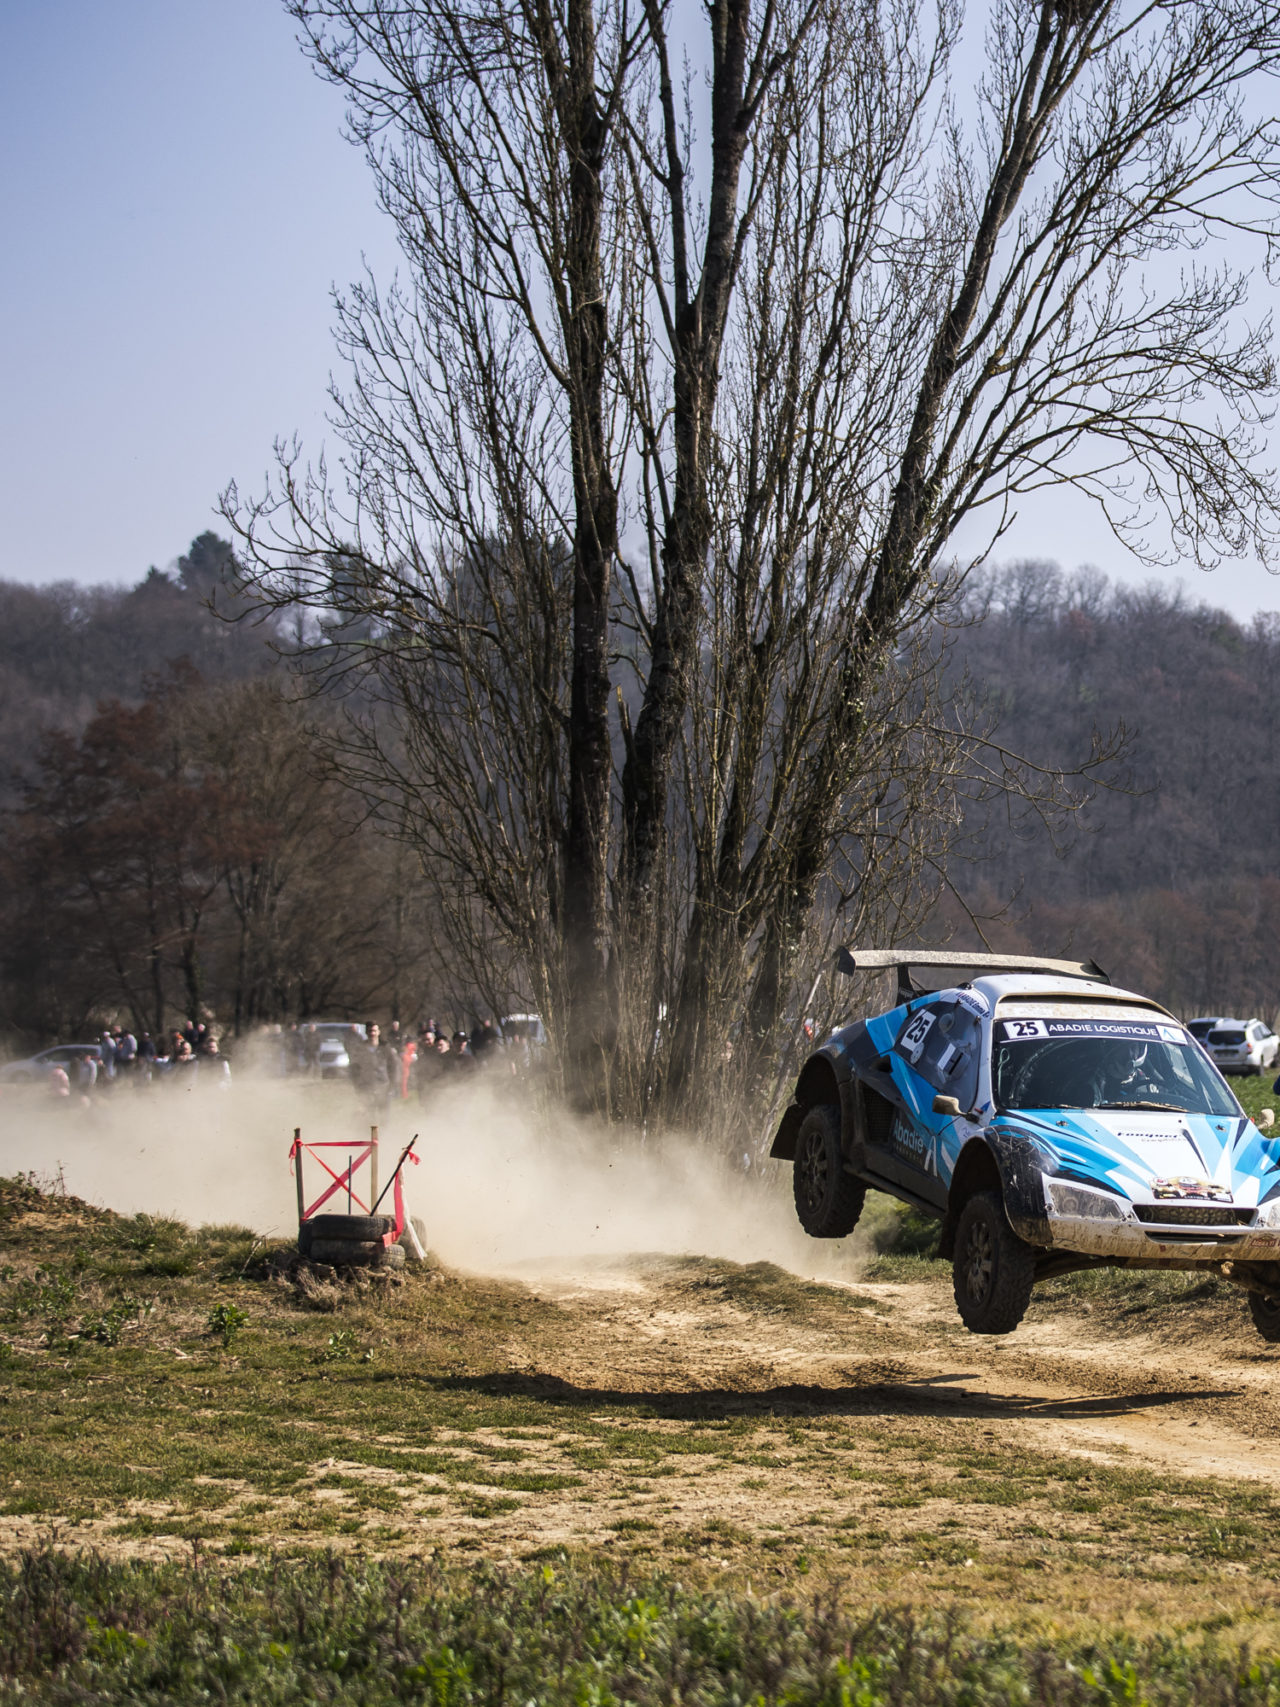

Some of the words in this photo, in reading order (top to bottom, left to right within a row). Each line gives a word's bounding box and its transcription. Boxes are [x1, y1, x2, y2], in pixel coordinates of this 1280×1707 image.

[906, 1015, 930, 1044] 25
[1013, 1022, 1039, 1037] 25
[1049, 1023, 1092, 1032] ABADIE
[1095, 1024, 1158, 1036] LOGISTIQUE
[893, 1119, 924, 1154] Abadie
